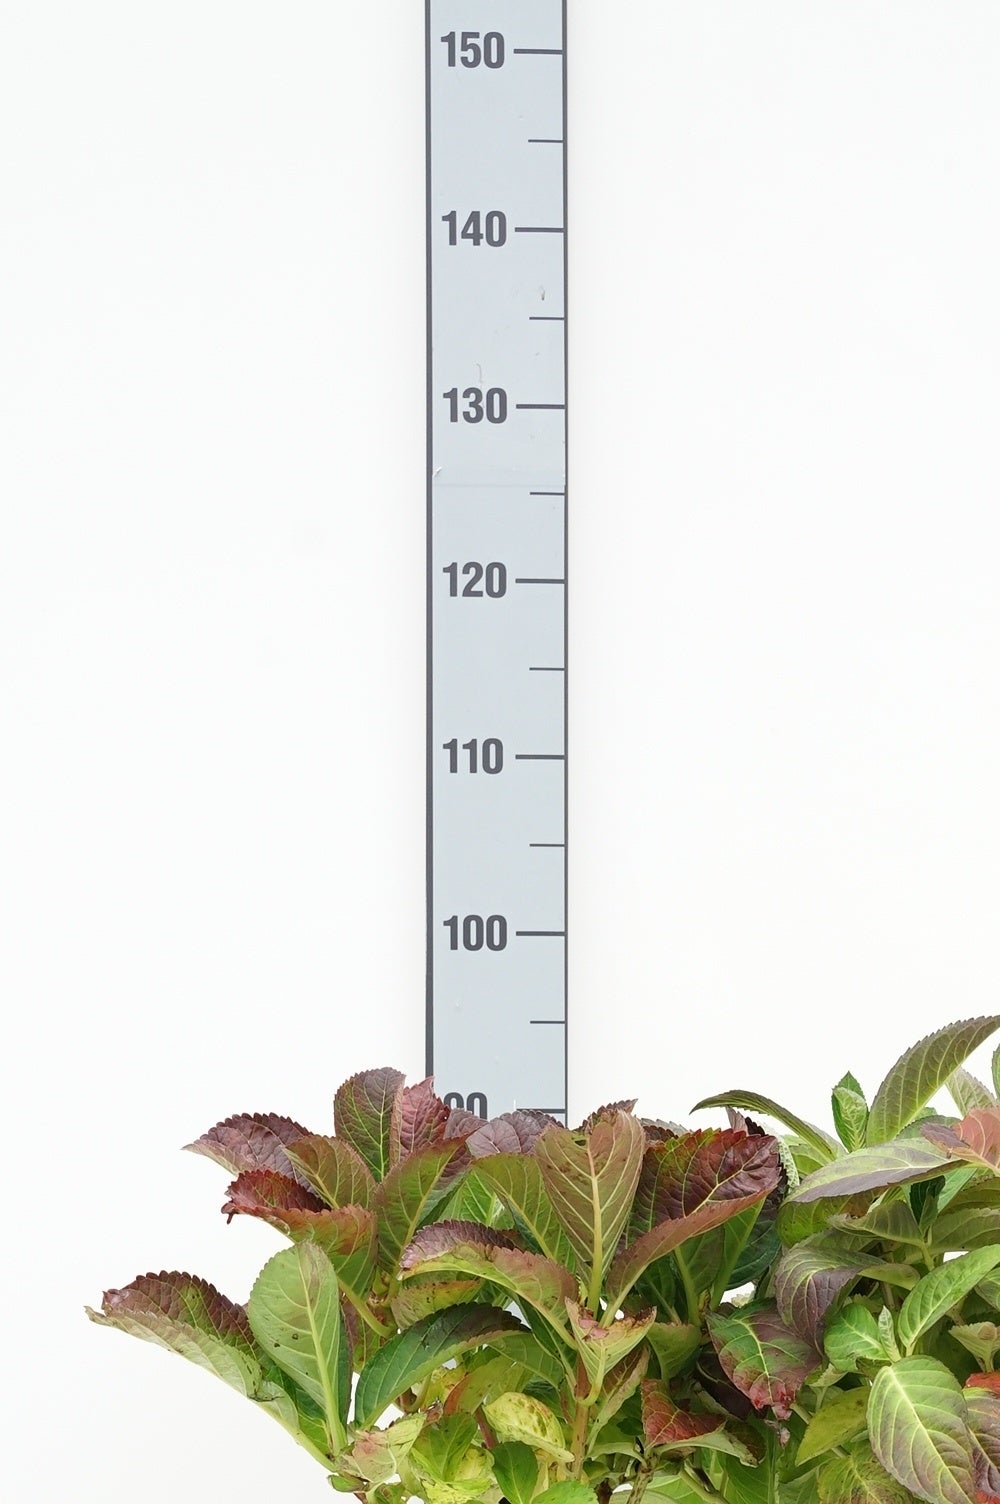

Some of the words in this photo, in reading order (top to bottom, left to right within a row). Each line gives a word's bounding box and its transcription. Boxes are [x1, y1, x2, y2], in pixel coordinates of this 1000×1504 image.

[441, 31, 505, 69] 150
[442, 210, 507, 247] 140
[442, 387, 508, 424] 130
[442, 561, 507, 598] 120
[442, 737, 504, 774] 110
[443, 914, 508, 951] 100
